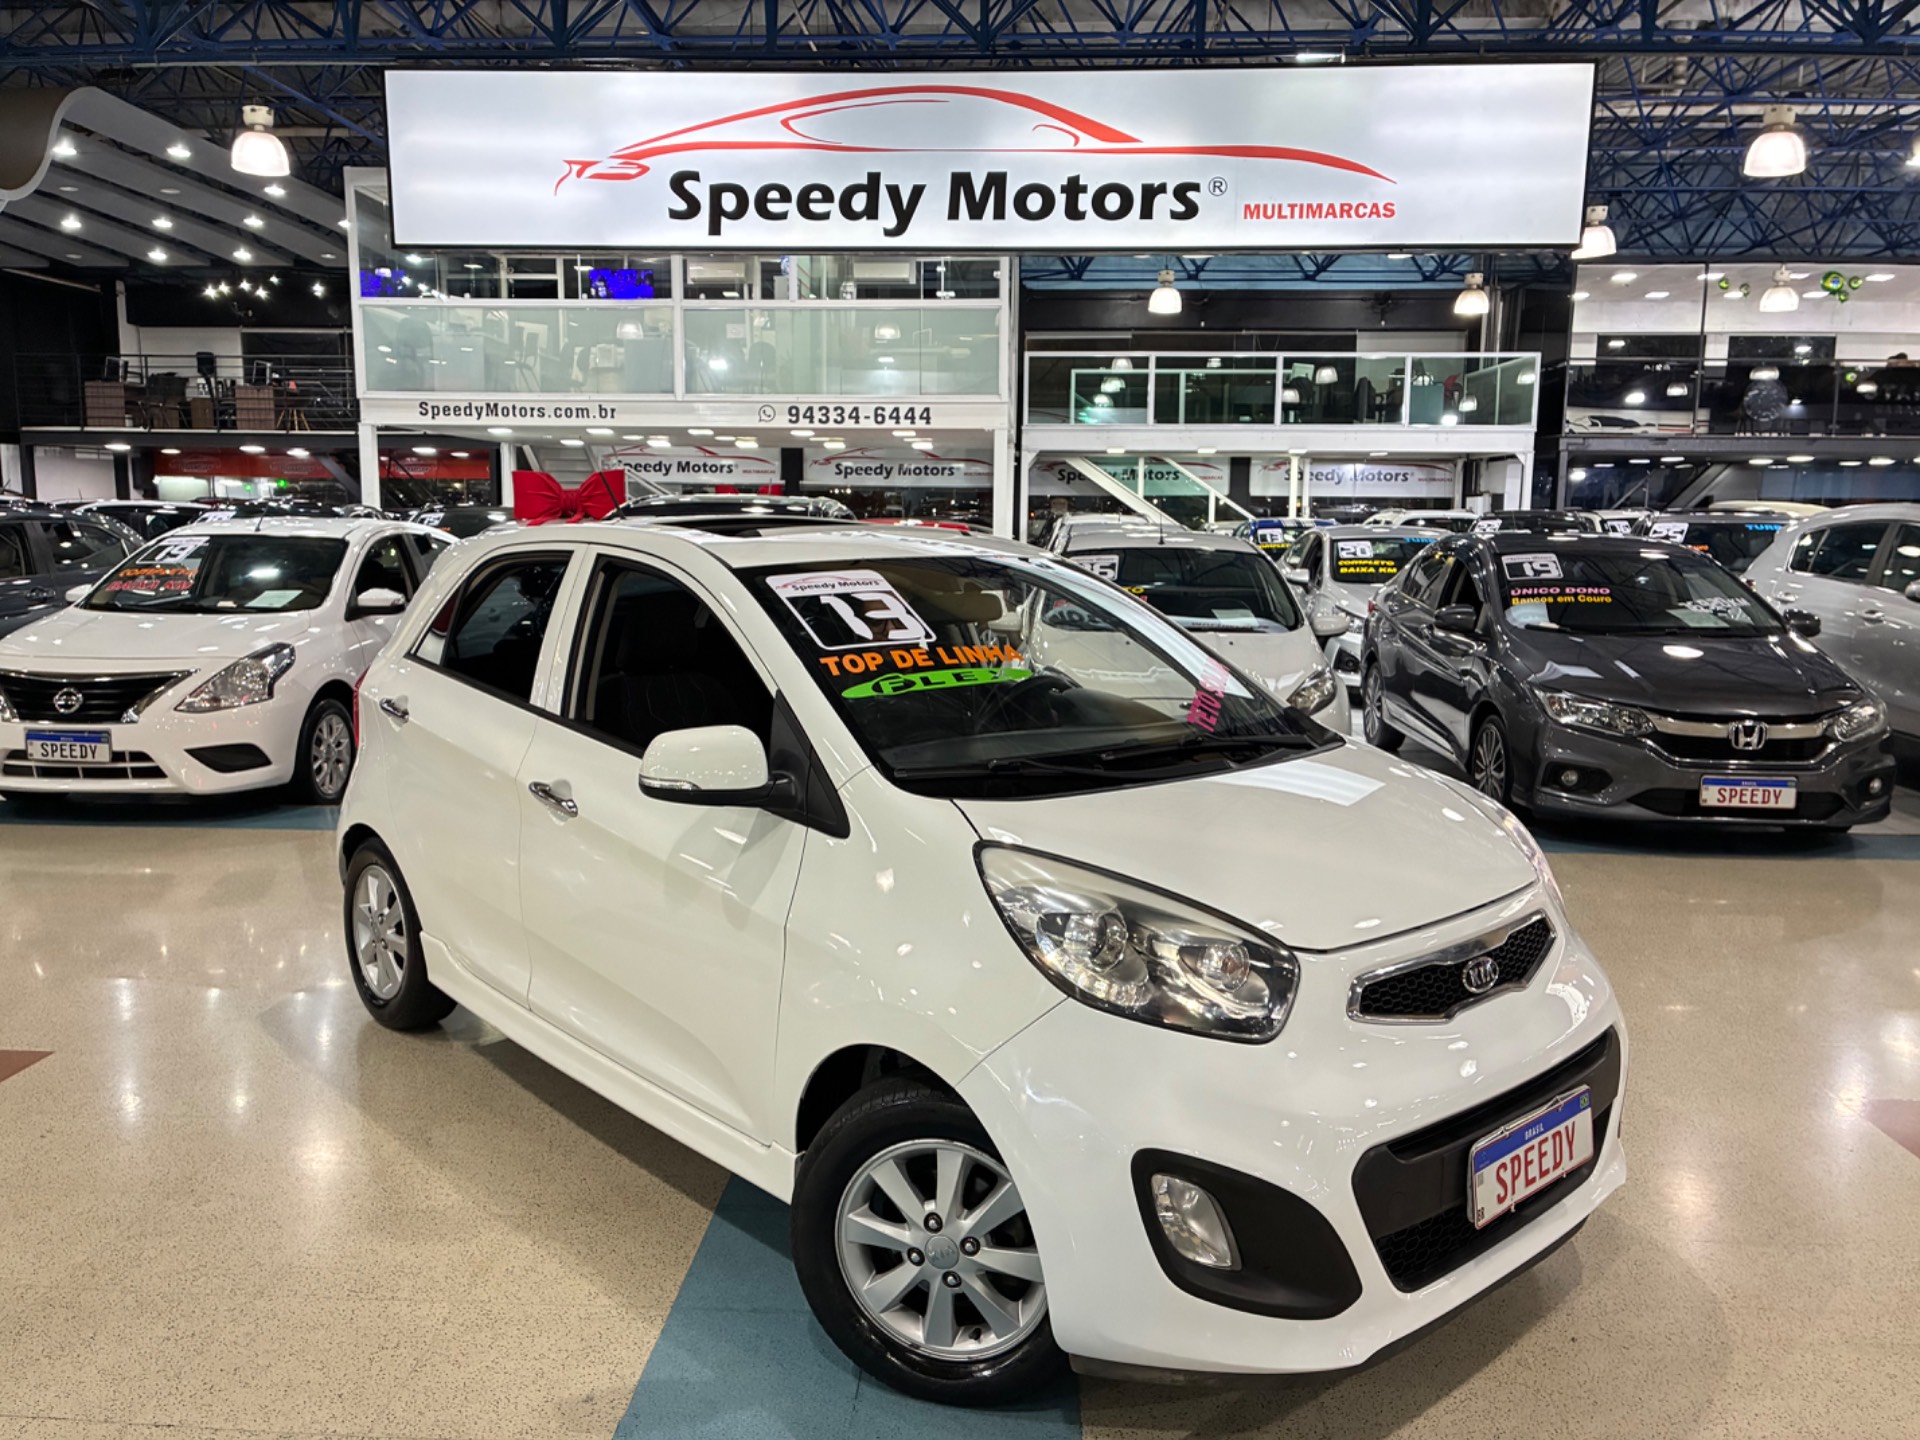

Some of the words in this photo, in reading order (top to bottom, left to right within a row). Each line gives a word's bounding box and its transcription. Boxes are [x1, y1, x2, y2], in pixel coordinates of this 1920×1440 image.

[667, 169, 927, 238] Speedy
[1243, 201, 1397, 221] MULTIMARCAS
[418, 401, 617, 421] SpeedyMotors.com.br
[787, 405, 933, 427] 94334-6444
[617, 460, 673, 477] peedy
[676, 460, 734, 474] Motors
[834, 463, 894, 480] Speedy
[897, 463, 956, 477] Motors
[1121, 468, 1180, 482] Mtors
[1339, 545, 1371, 558] 20
[1339, 566, 1376, 574] BAIXA
[1378, 566, 1398, 574] KM
[1522, 561, 1560, 577] 19
[791, 582, 836, 592] Speedy
[837, 579, 881, 588] Motors
[1510, 586, 1561, 596] ÚNICO
[1564, 586, 1611, 595] DONO
[1511, 596, 1554, 606] Bancos
[1556, 595, 1575, 603] em
[1577, 594, 1612, 603] Couro
[820, 592, 926, 641] 13
[819, 655, 884, 677] TOP
[893, 649, 934, 668] DE
[938, 644, 1025, 666] LINHA
[40, 742, 98, 759] SPEEDY
[1716, 787, 1782, 805] SPEEDY
[1495, 1120, 1576, 1206] SPEEDY
